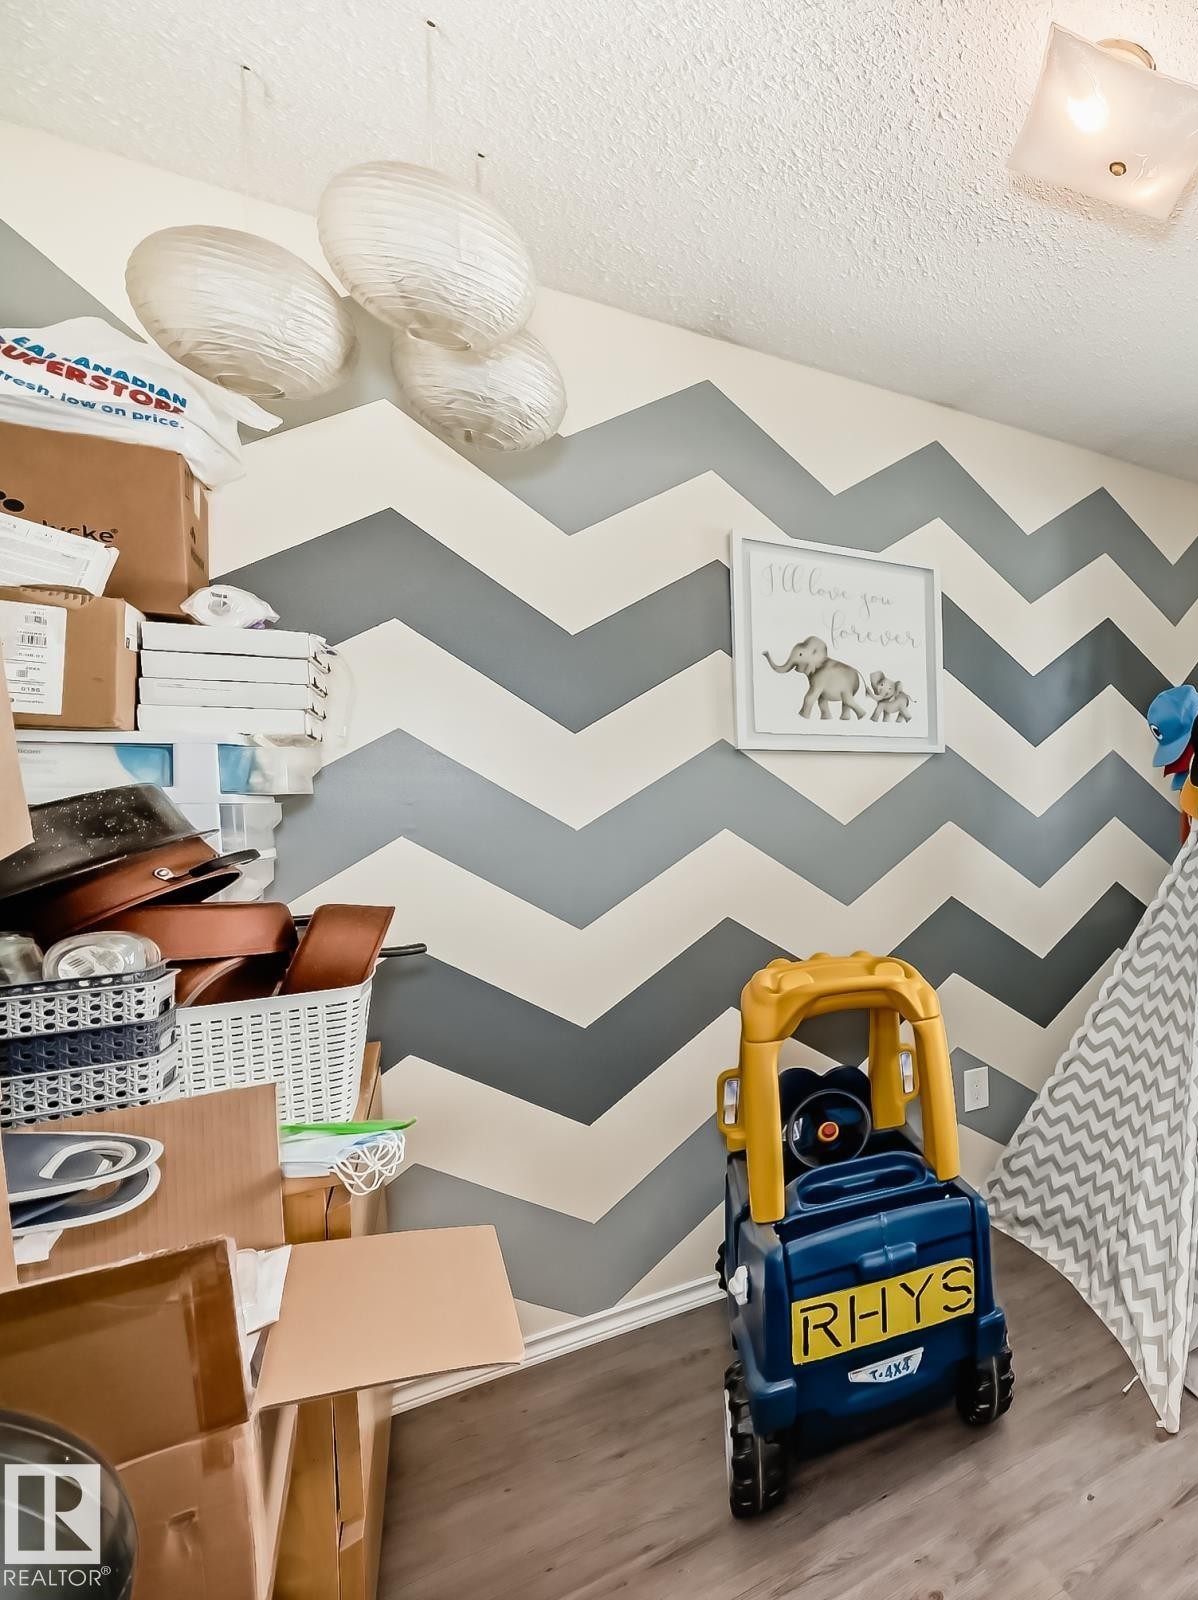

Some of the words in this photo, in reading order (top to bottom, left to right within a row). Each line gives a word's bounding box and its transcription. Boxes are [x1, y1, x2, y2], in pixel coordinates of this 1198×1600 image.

[101, 405, 126, 417] on
[762, 562, 801, 597] I'll
[809, 567, 849, 601] love
[861, 591, 894, 617] you
[823, 610, 920, 650] forever
[800, 1266, 973, 1357] RHYS
